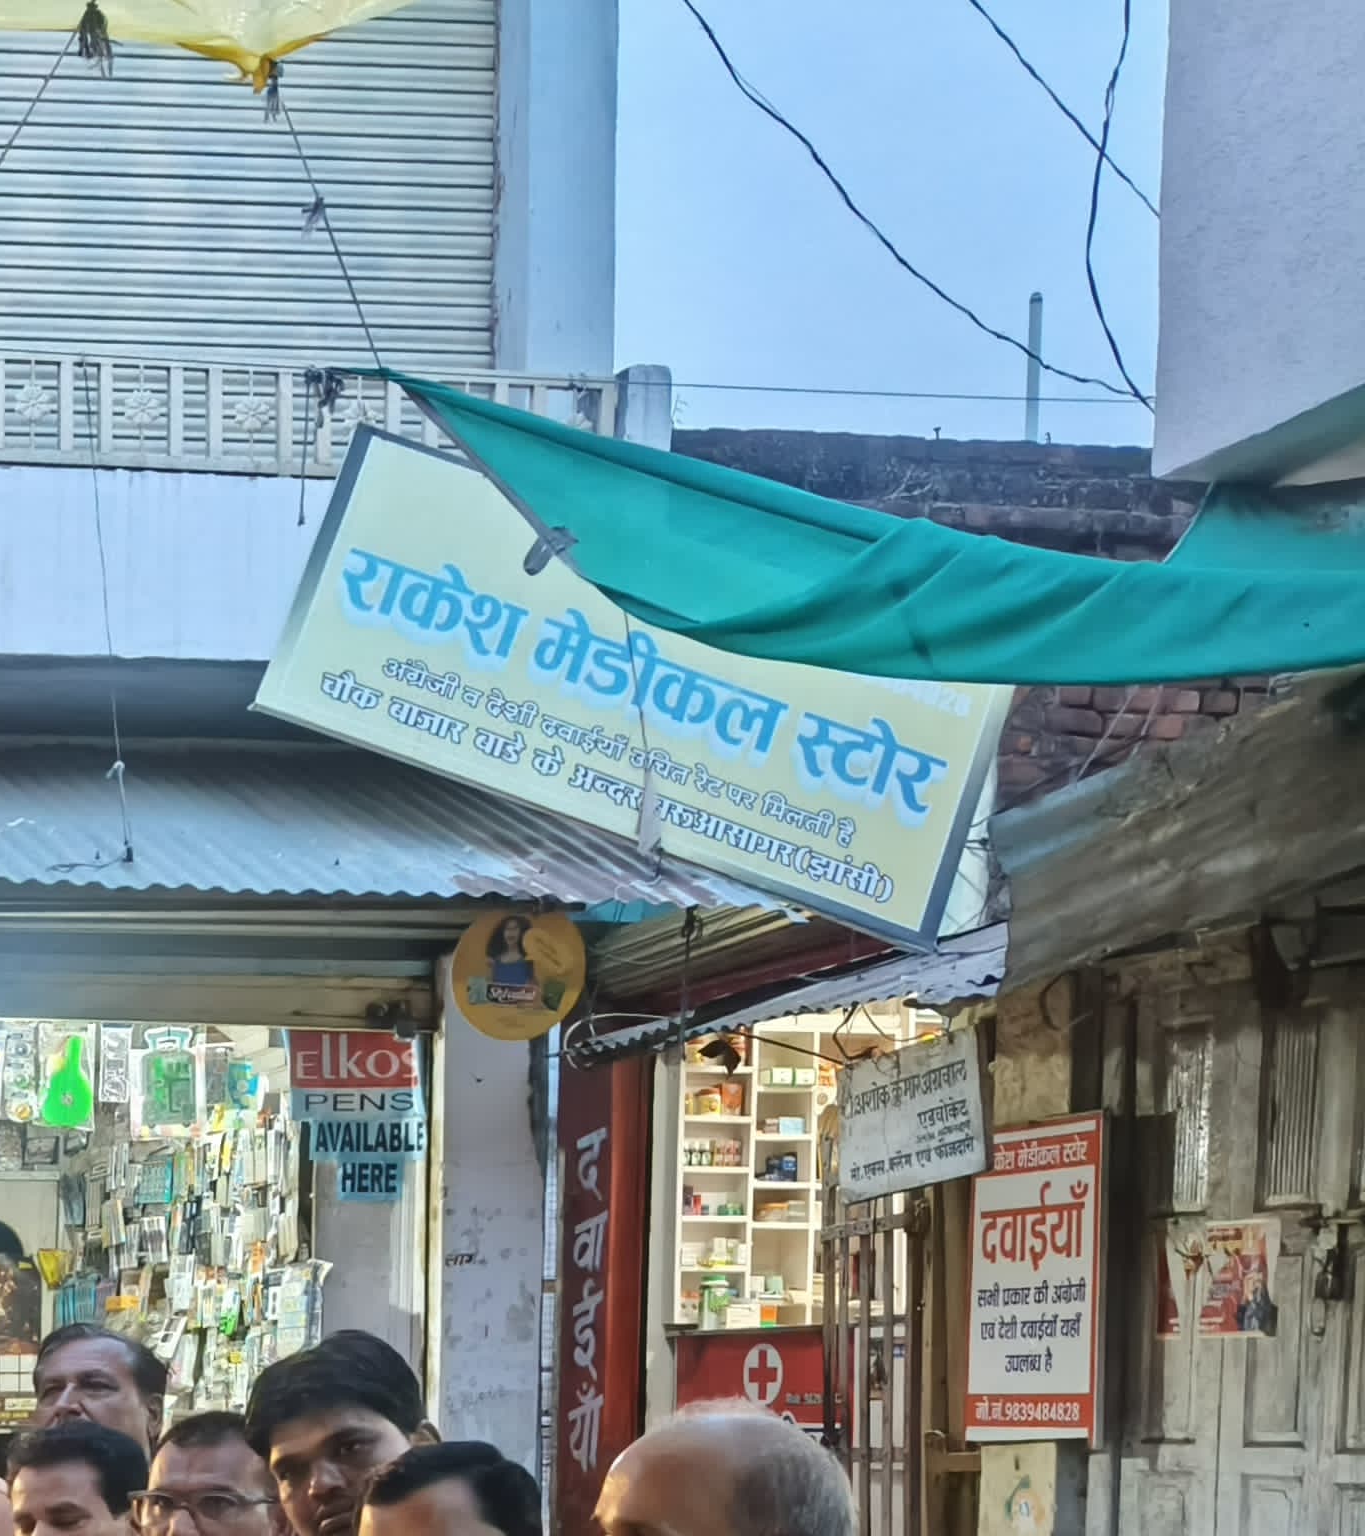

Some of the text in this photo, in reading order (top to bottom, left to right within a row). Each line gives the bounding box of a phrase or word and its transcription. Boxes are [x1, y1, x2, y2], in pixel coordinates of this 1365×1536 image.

[341, 546, 949, 814] राकेश मेडीकल स्टोर
[321, 669, 383, 710] चौक
[388, 696, 470, 744] बाजार
[531, 745, 566, 777] के
[485, 687, 539, 728] देशी
[693, 761, 726, 797] रेट
[726, 781, 758, 810] पर
[760, 790, 836, 838] मिलती
[304, 1092, 415, 1113] PENS
[314, 1120, 425, 1154] AVAILABLE
[340, 1162, 399, 1194] HERE
